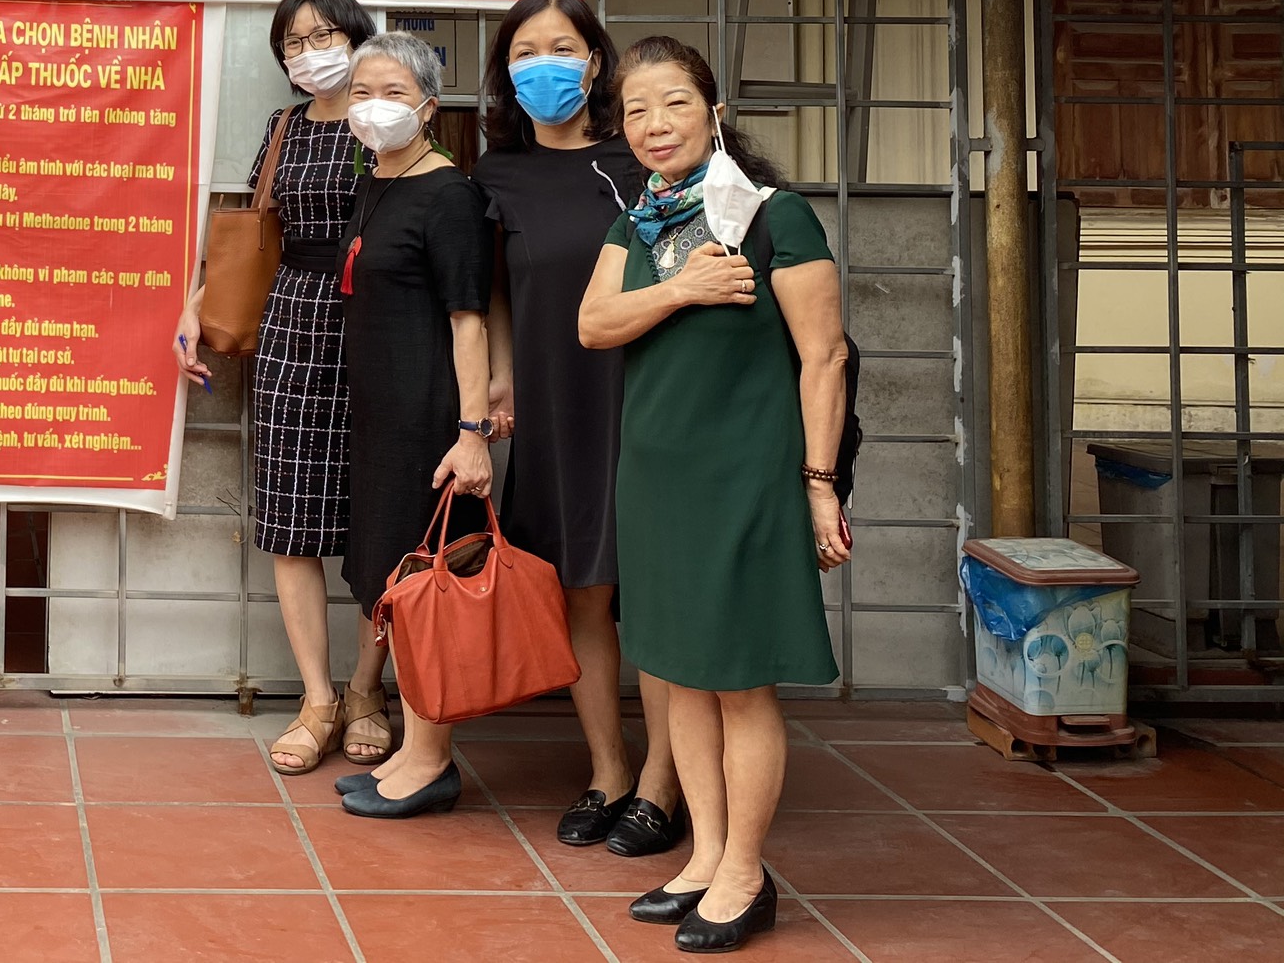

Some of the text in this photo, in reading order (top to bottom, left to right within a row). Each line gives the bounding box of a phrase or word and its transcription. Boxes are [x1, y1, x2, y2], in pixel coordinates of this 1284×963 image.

[12, 21, 64, 54] CHỌN
[70, 17, 118, 54] BỆNH
[124, 20, 178, 50] NHÂN
[28, 53, 92, 89] THUỐC
[97, 55, 122, 89] VỀ
[126, 61, 165, 90] NHÀ
[8, 104, 17, 119] 2
[20, 104, 55, 123] tháng
[59, 104, 77, 122] trở
[80, 107, 100, 123] lên
[105, 108, 146, 126] (không
[150, 108, 176, 127] tăng
[19, 158, 37, 174] âm
[40, 159, 63, 175] tính
[65, 160, 83, 176] với
[86, 161, 108, 177] các
[110, 162, 133, 181] loại
[135, 164, 154, 178] ma
[156, 163, 175, 181] túy
[6, 212, 19, 230] trị
[23, 212, 90, 230] Methadone
[94, 216, 125, 233] trong
[128, 216, 136, 232] 2
[139, 216, 173, 234] tháng
[38, 266, 49, 282] vi
[53, 267, 87, 286] phạm
[92, 268, 114, 284] các
[118, 272, 140, 287] quy
[144, 270, 171, 289] định
[1, 316, 22, 337] đầy
[24, 317, 39, 336] đủ
[41, 319, 71, 338] đúng
[73, 321, 99, 341] hạn.
[9, 347, 22, 366] tự
[23, 347, 38, 367] tại
[40, 349, 55, 364] cơ
[57, 346, 75, 365] sở.
[26, 372, 47, 393] đầy
[50, 374, 64, 392] đủ
[66, 376, 85, 393] khi
[87, 375, 117, 396] uống
[120, 377, 157, 395] thuốc.
[24, 403, 53, 422] đúng
[56, 407, 77, 422] quy
[79, 404, 111, 421] trình.
[23, 431, 37, 447] tư
[37, 428, 62, 449] vấn,
[64, 432, 83, 449] xét
[85, 432, 142, 453] nghiệm...
